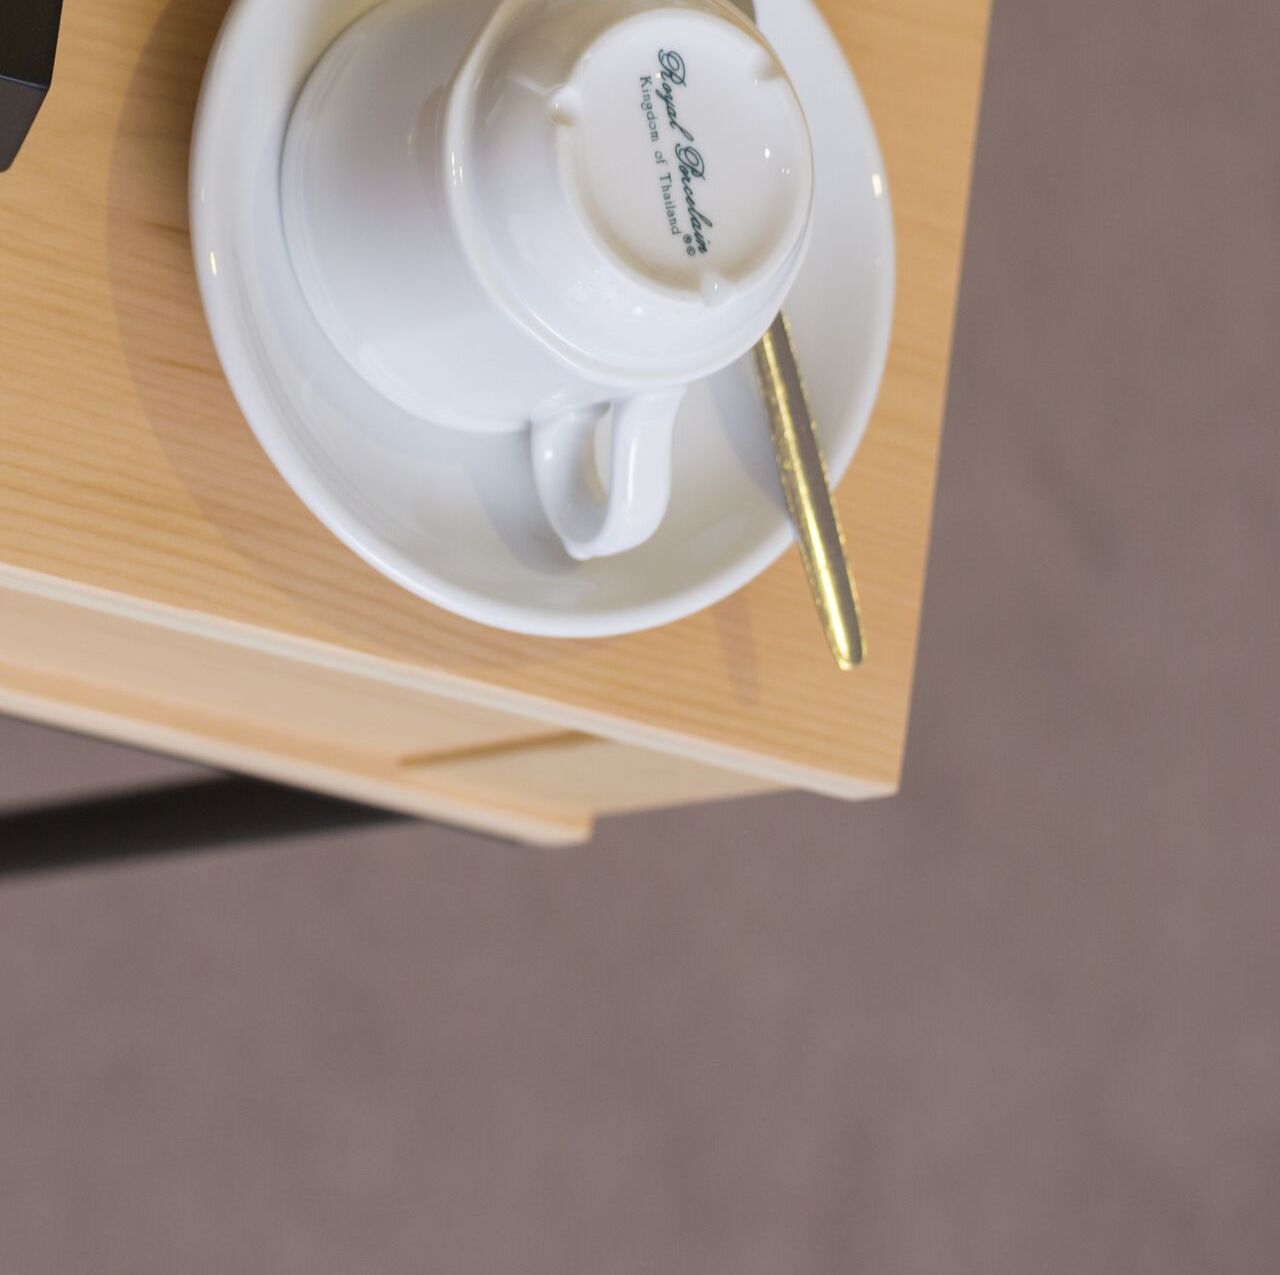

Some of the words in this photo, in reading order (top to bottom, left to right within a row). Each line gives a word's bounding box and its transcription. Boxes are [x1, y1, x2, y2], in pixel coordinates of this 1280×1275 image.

[640, 75, 659, 142] Kingdom
[654, 150, 668, 165] of
[655, 49, 694, 142] Royal
[675, 143, 713, 255] Porcelain
[659, 172, 681, 236] Thailand
